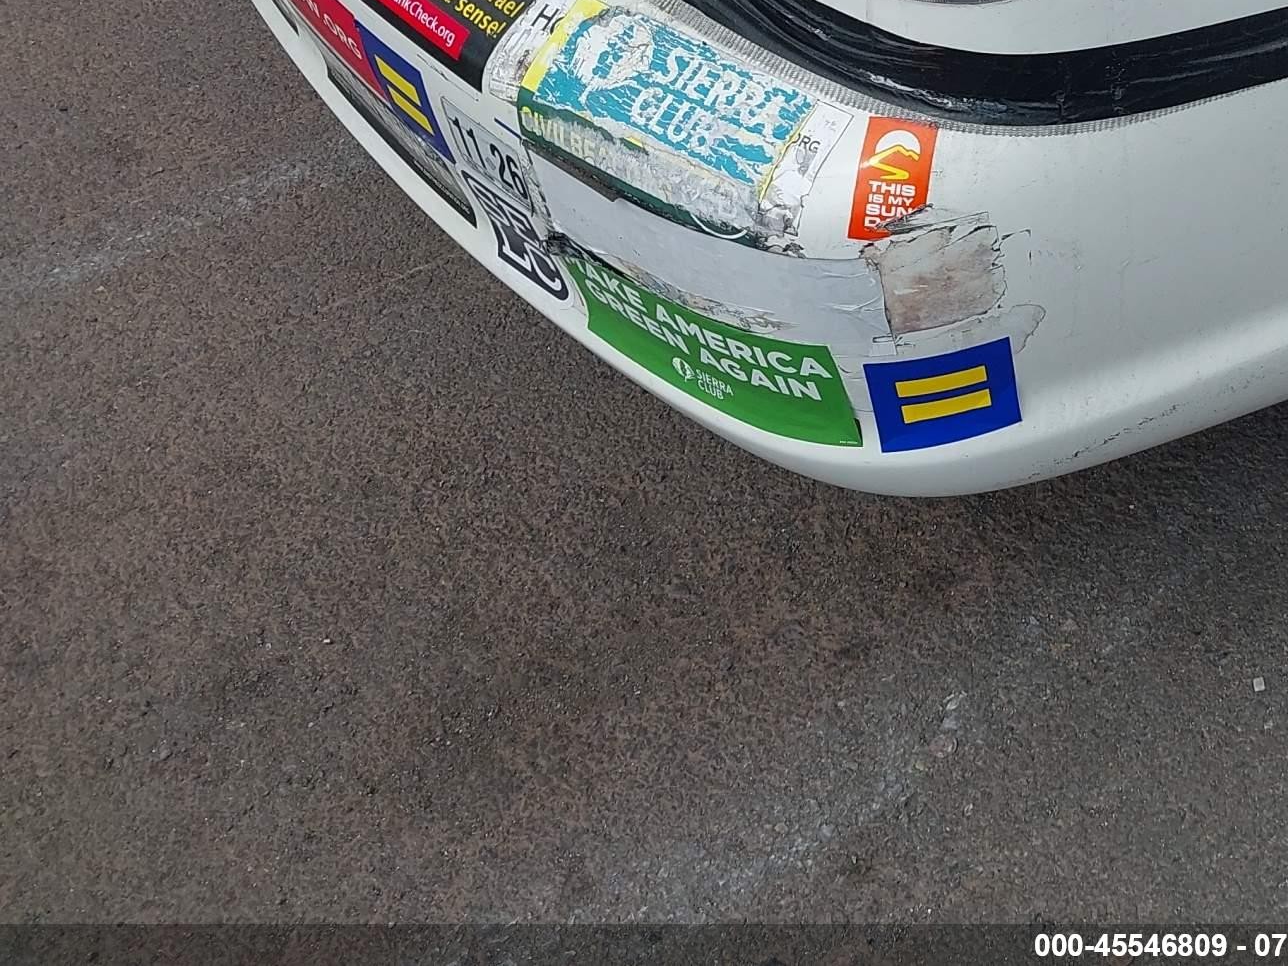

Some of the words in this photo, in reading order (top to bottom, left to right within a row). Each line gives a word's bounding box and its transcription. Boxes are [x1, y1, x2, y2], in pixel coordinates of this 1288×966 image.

[651, 46, 786, 141] SIERRA
[631, 87, 719, 156] CLUB
[452, 116, 487, 169] 11
[490, 144, 528, 200] 26
[865, 204, 914, 218] SUN
[868, 179, 916, 197] THIS
[869, 194, 884, 204] IS
[888, 195, 914, 206] MY
[585, 278, 690, 355] GREEN
[701, 346, 822, 401] AGAIN
[656, 304, 833, 378] AMERICA
[695, 368, 734, 396] SIERRA
[697, 379, 724, 400] CLUB
